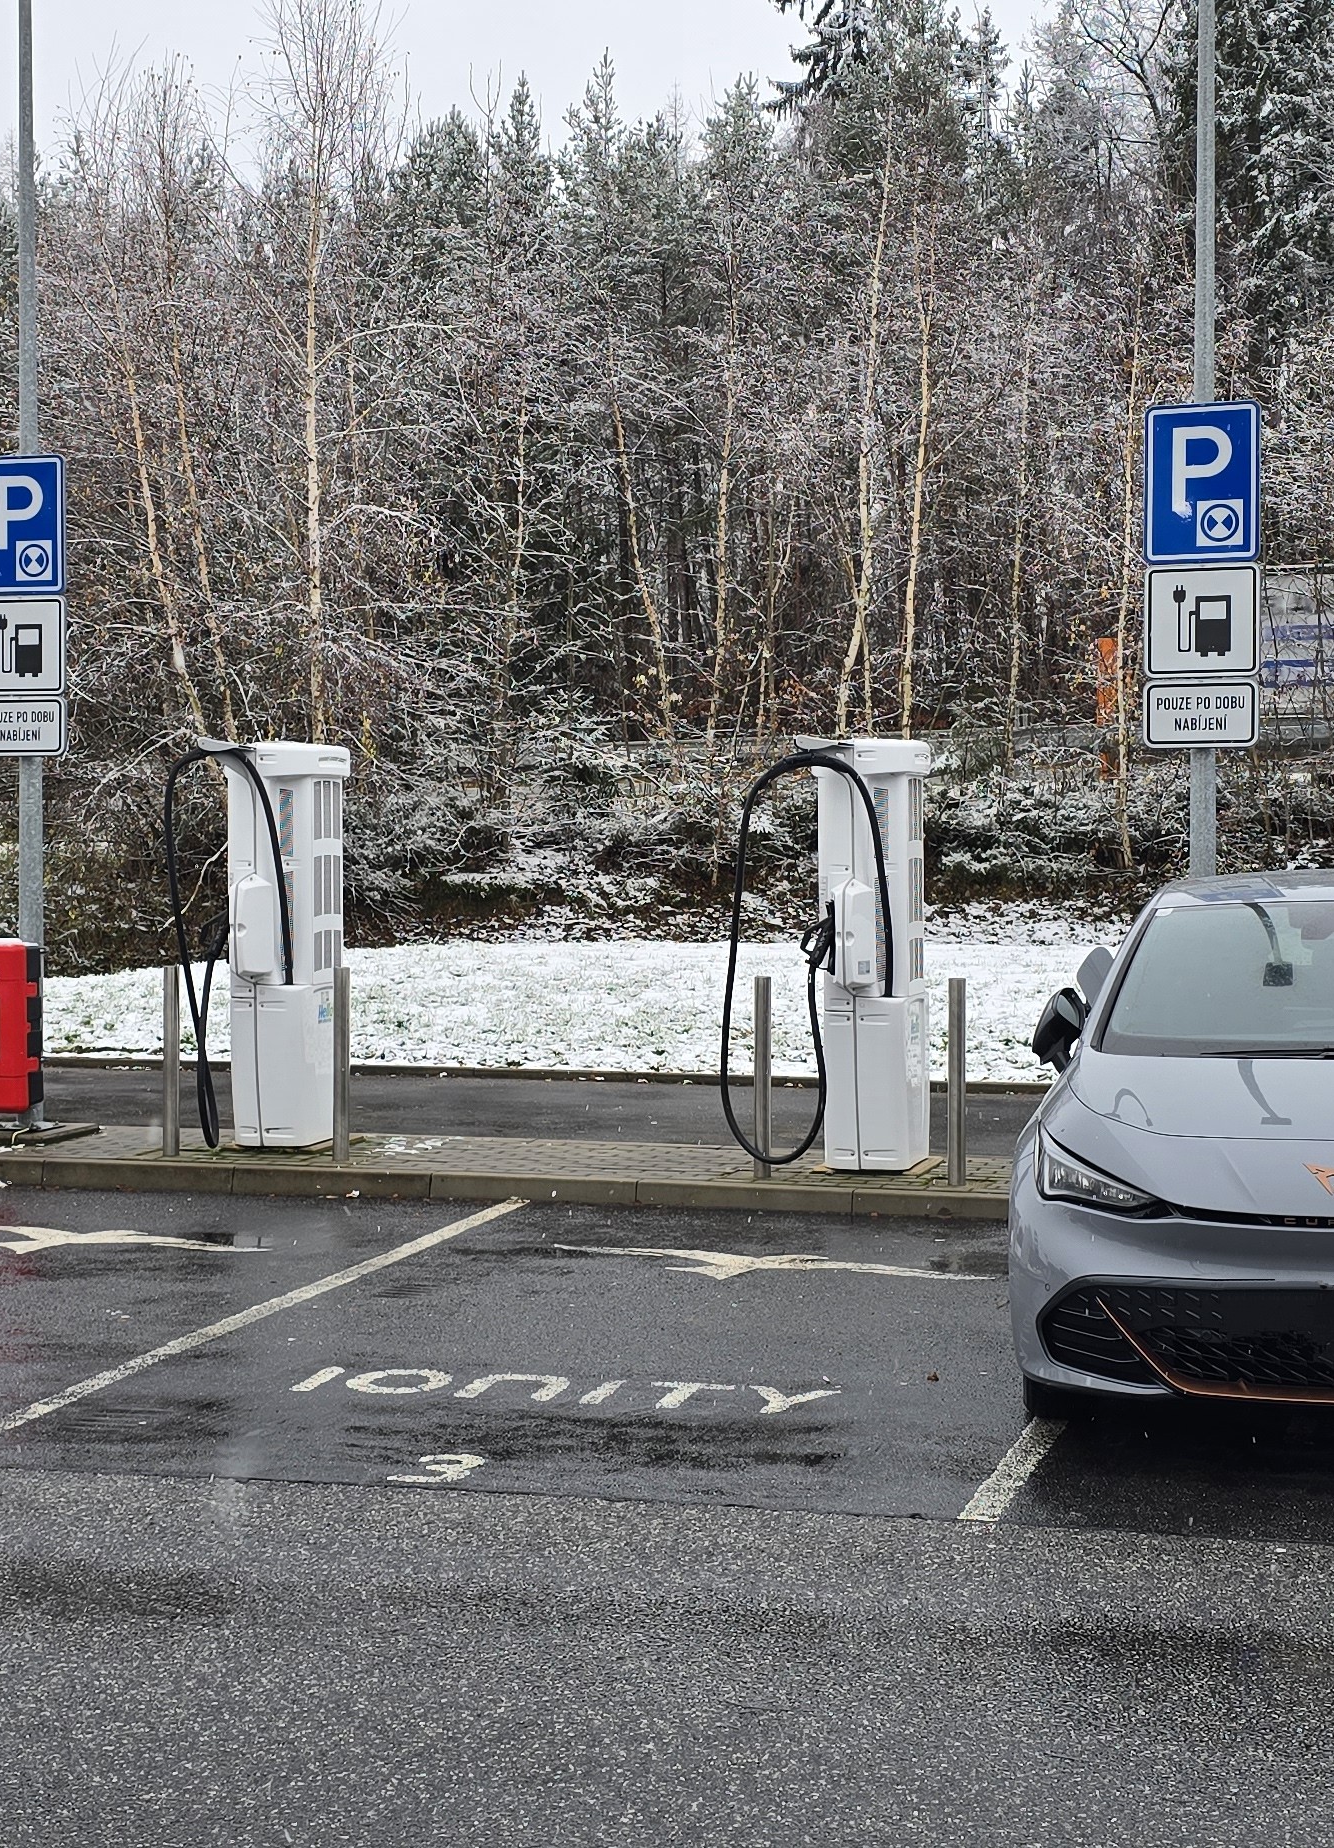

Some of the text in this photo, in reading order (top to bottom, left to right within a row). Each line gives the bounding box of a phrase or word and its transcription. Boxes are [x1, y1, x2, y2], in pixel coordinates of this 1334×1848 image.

[1172, 425, 1233, 517] P
[1156, 695, 1245, 711] POUZE PO DOBU
[16, 712, 29, 723] PO
[31, 711, 55, 723] DOBU
[1174, 713, 1228, 731] NABÍJENÍ
[0, 726, 41, 742] NABÍJENÍ
[289, 1366, 842, 1414] IONITY
[386, 1453, 486, 1483] 3
